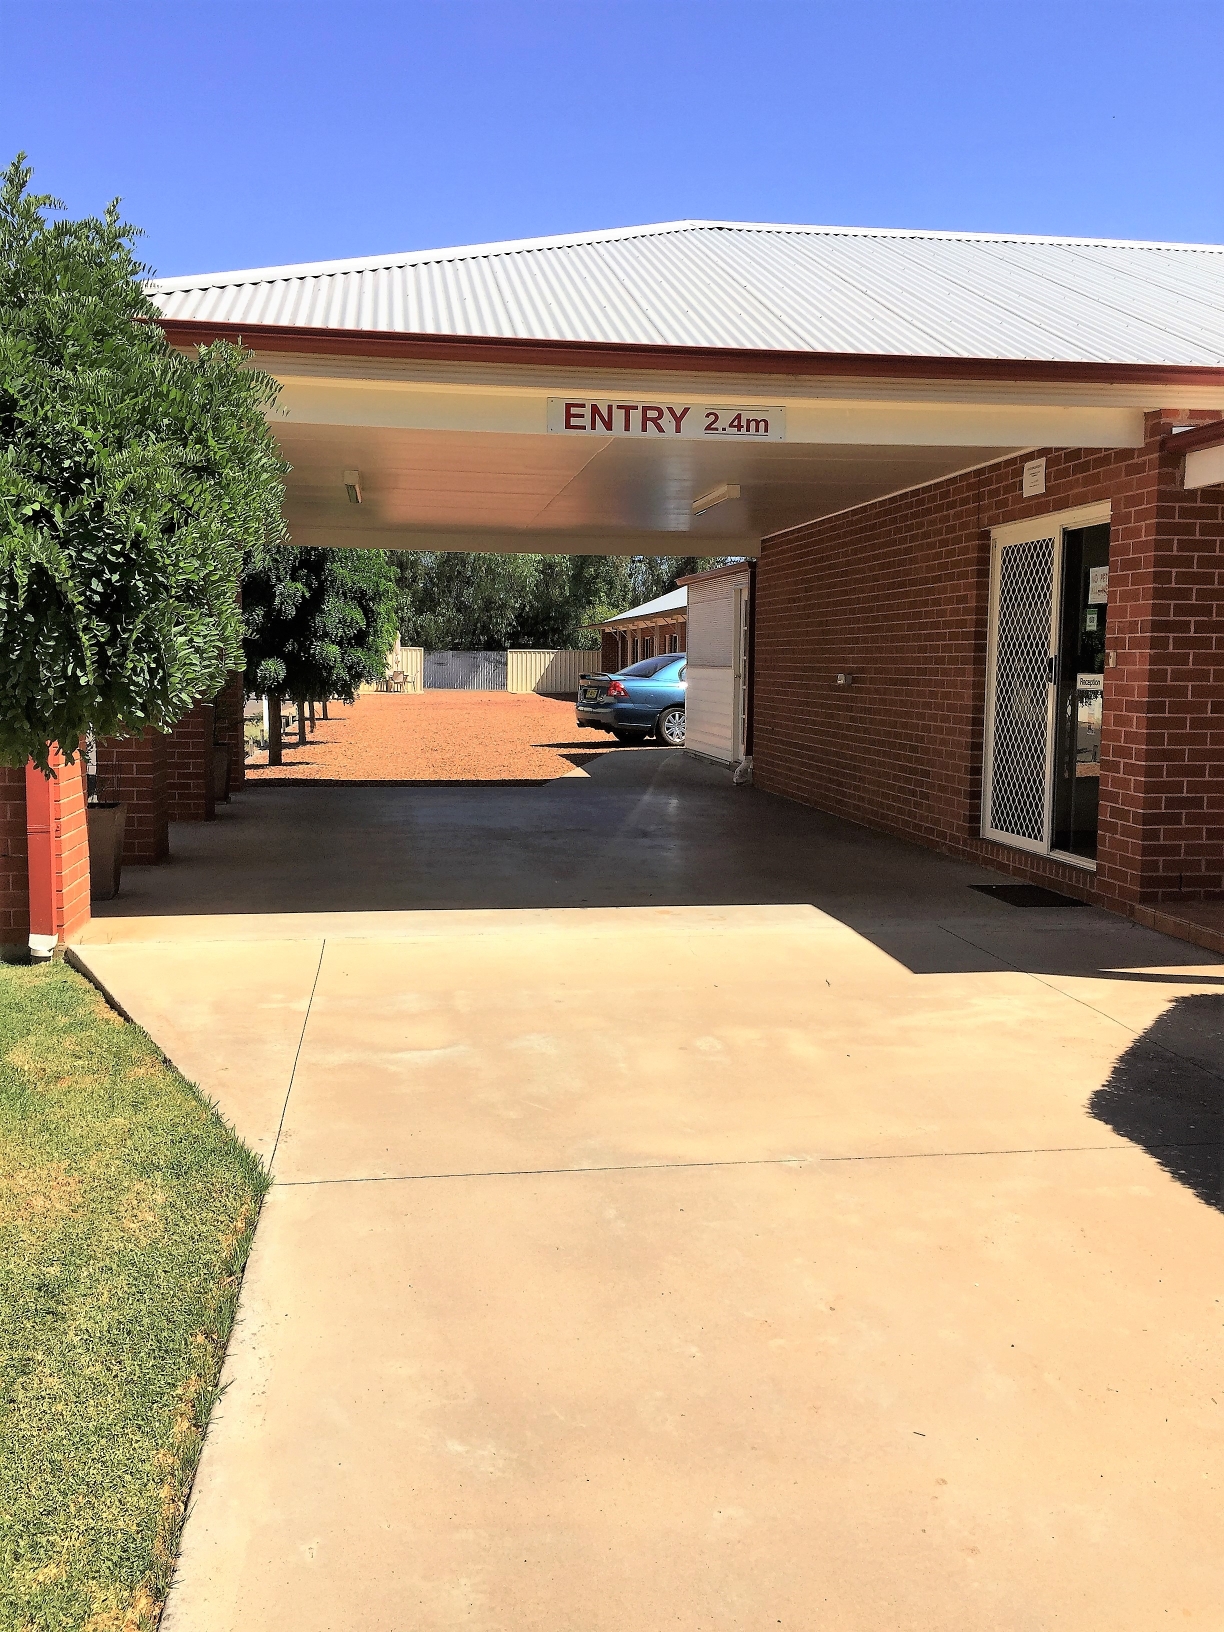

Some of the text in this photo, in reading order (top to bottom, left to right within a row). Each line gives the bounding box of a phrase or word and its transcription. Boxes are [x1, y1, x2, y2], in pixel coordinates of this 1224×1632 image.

[564, 402, 769, 434] ENTRY 2.4m
[1080, 677, 1101, 688] Reception
